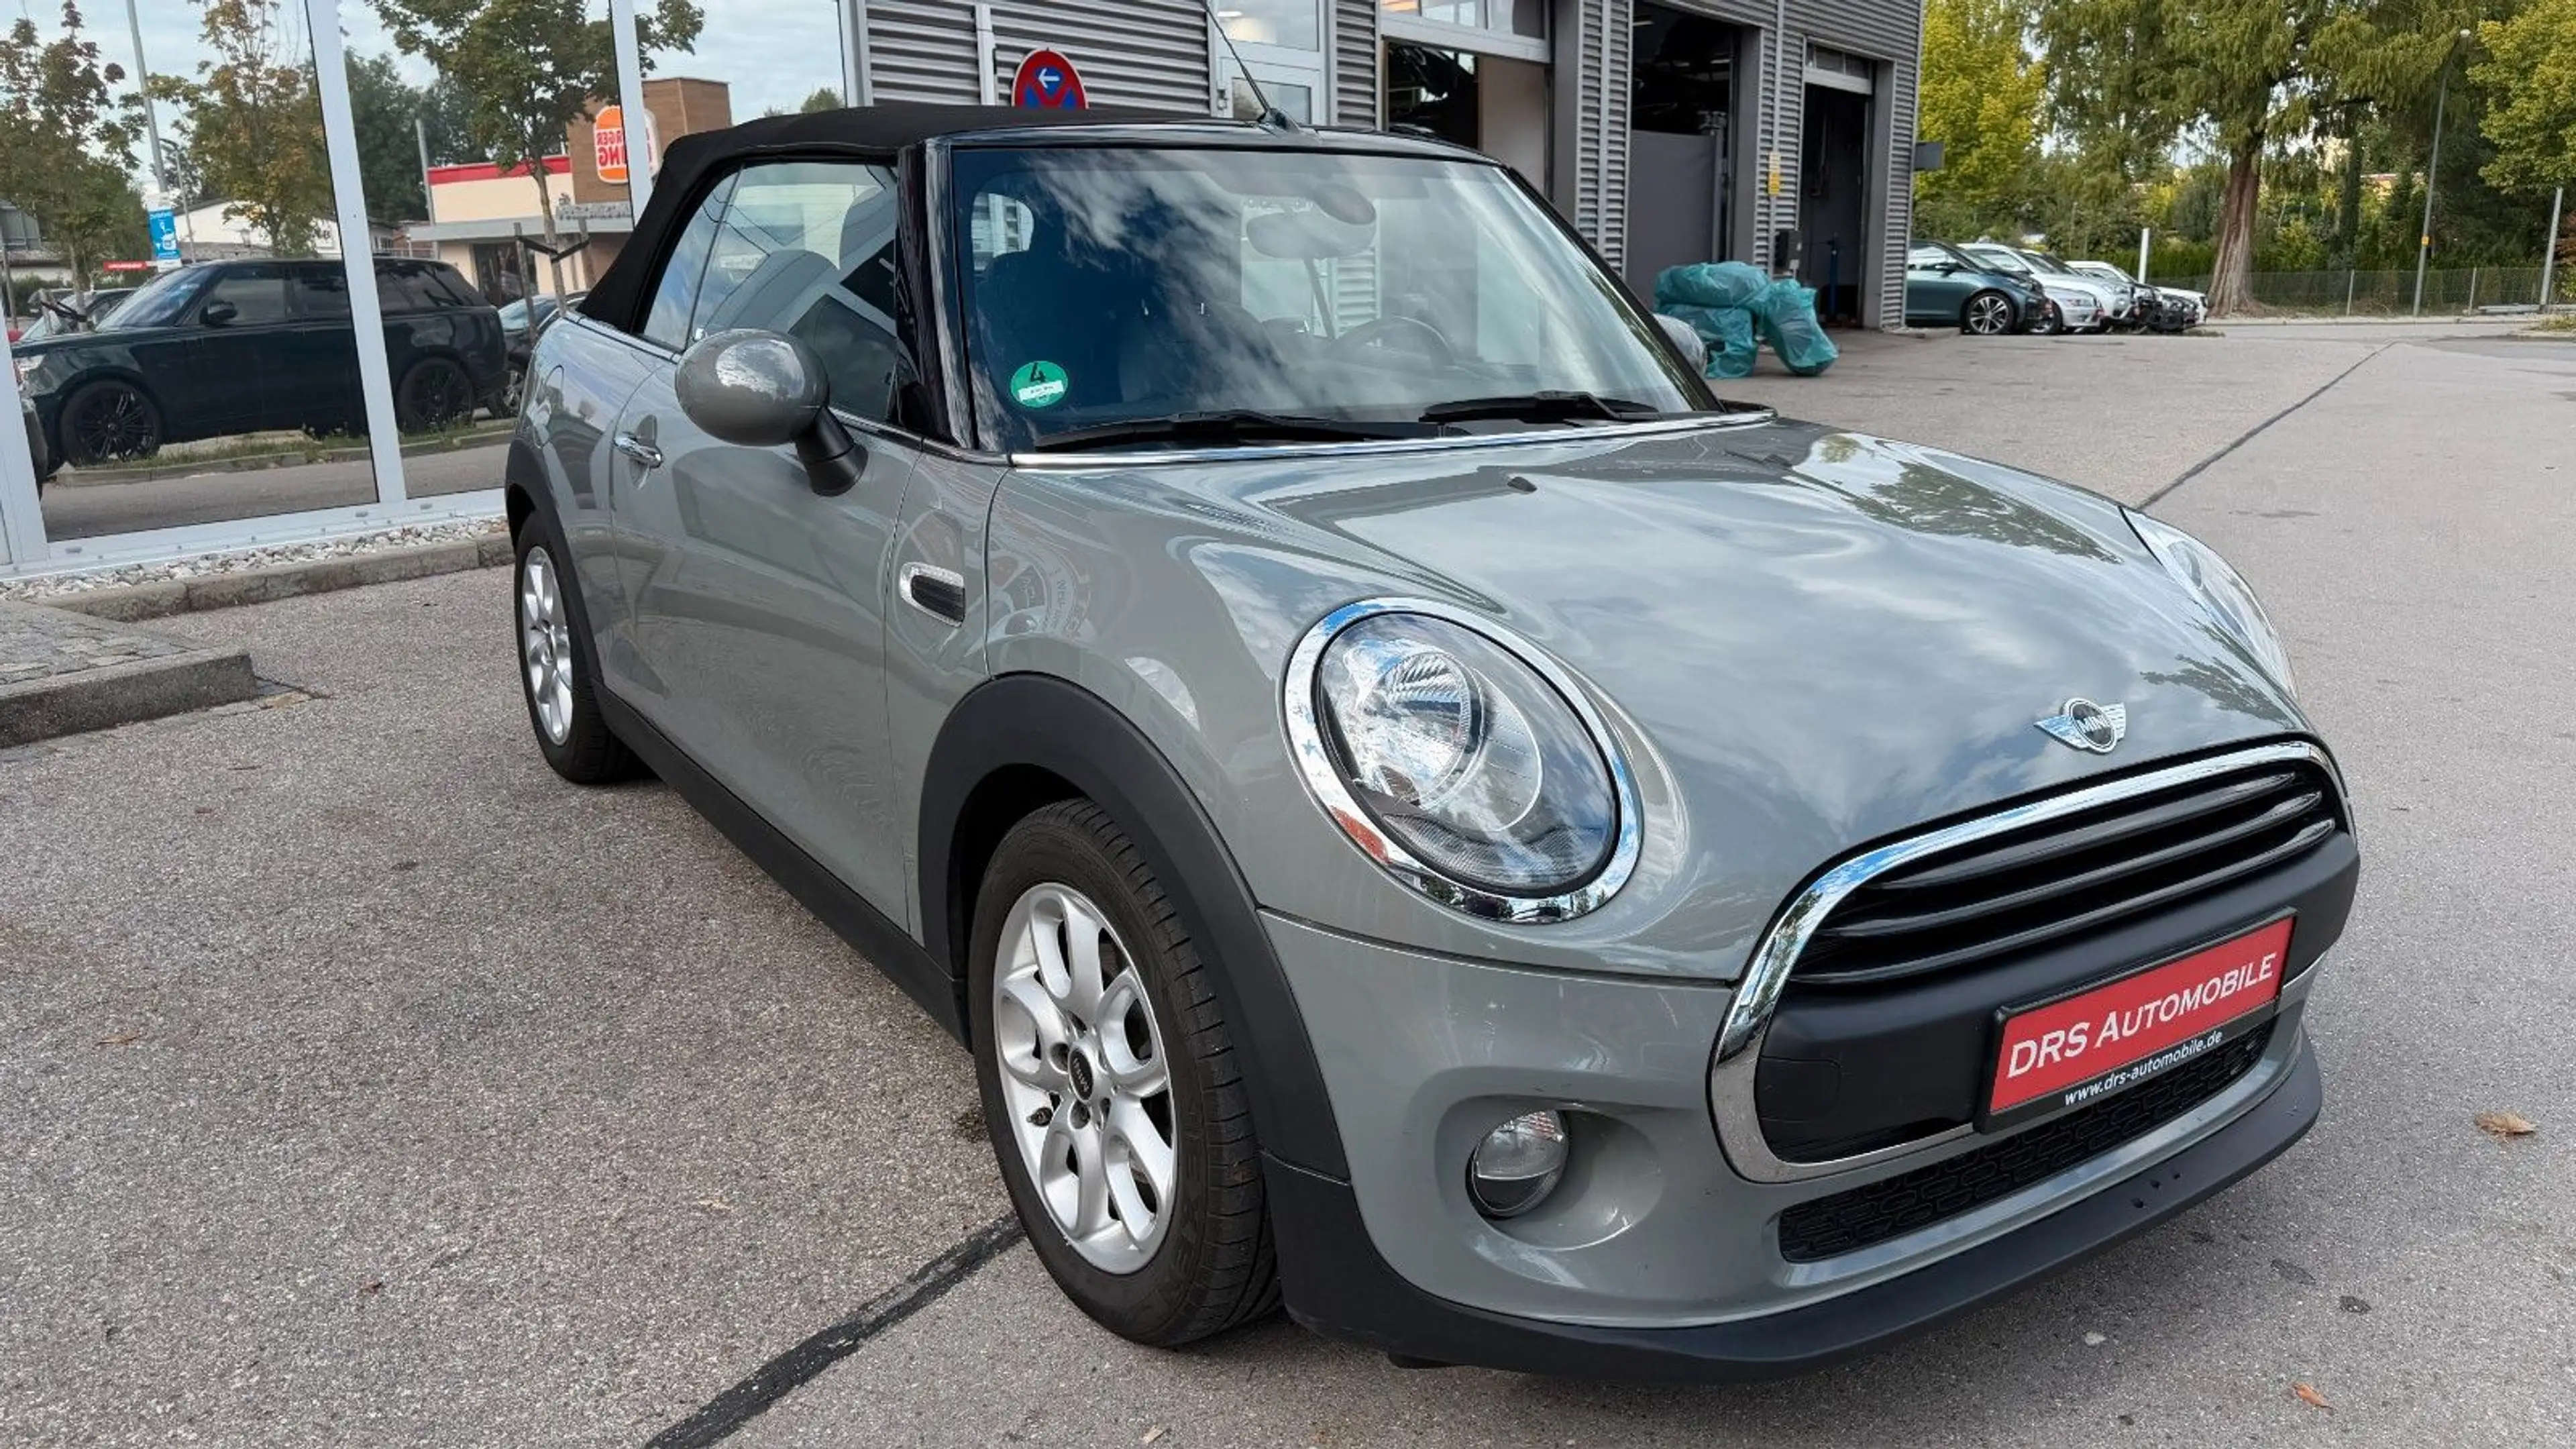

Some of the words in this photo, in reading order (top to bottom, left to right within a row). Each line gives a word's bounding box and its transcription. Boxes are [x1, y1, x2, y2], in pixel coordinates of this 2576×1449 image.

[1030, 363, 1045, 382] 4
[2008, 1022, 2090, 1079] DRS
[2094, 953, 2277, 1049] AUTOMOBILE
[2064, 1030, 2224, 1106] www.drs-automobile.de
